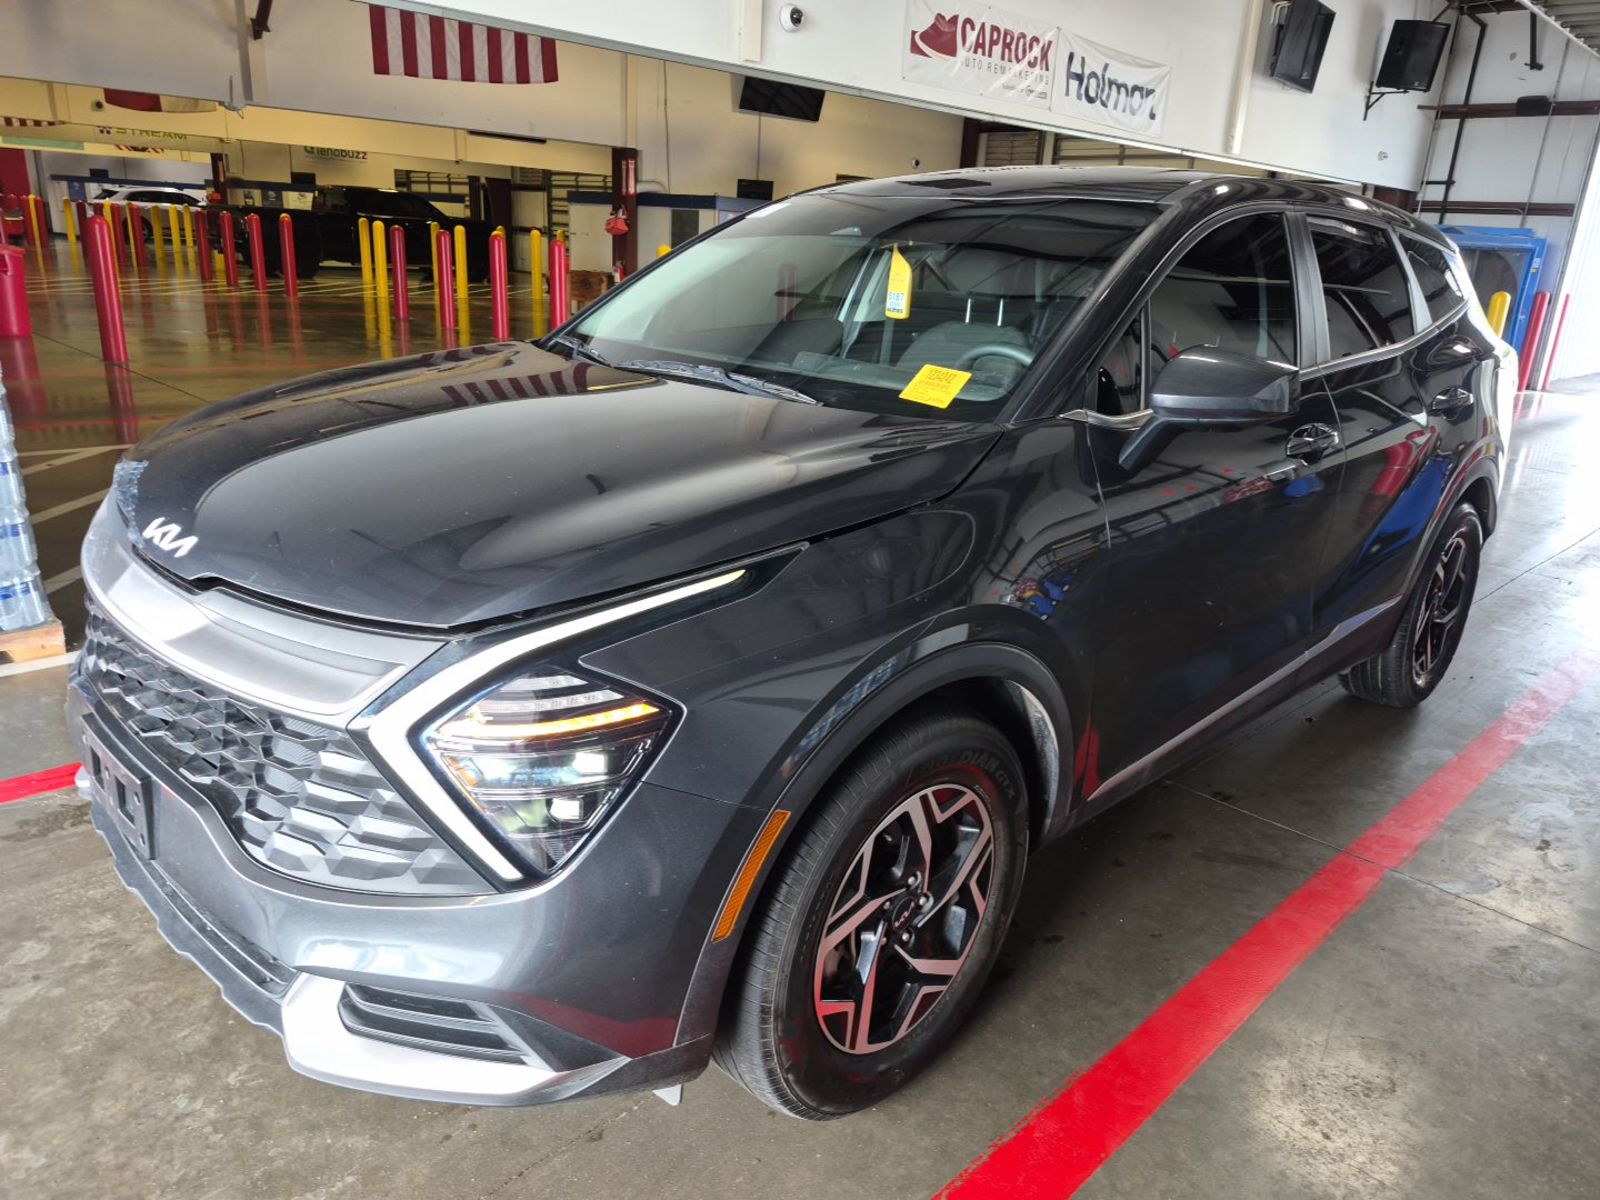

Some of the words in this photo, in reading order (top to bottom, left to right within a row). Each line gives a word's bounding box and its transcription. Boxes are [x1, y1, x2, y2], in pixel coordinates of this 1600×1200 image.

[961, 17, 1053, 72] CAPROCK
[961, 57, 983, 71] UTO
[142, 516, 199, 558] KIA
